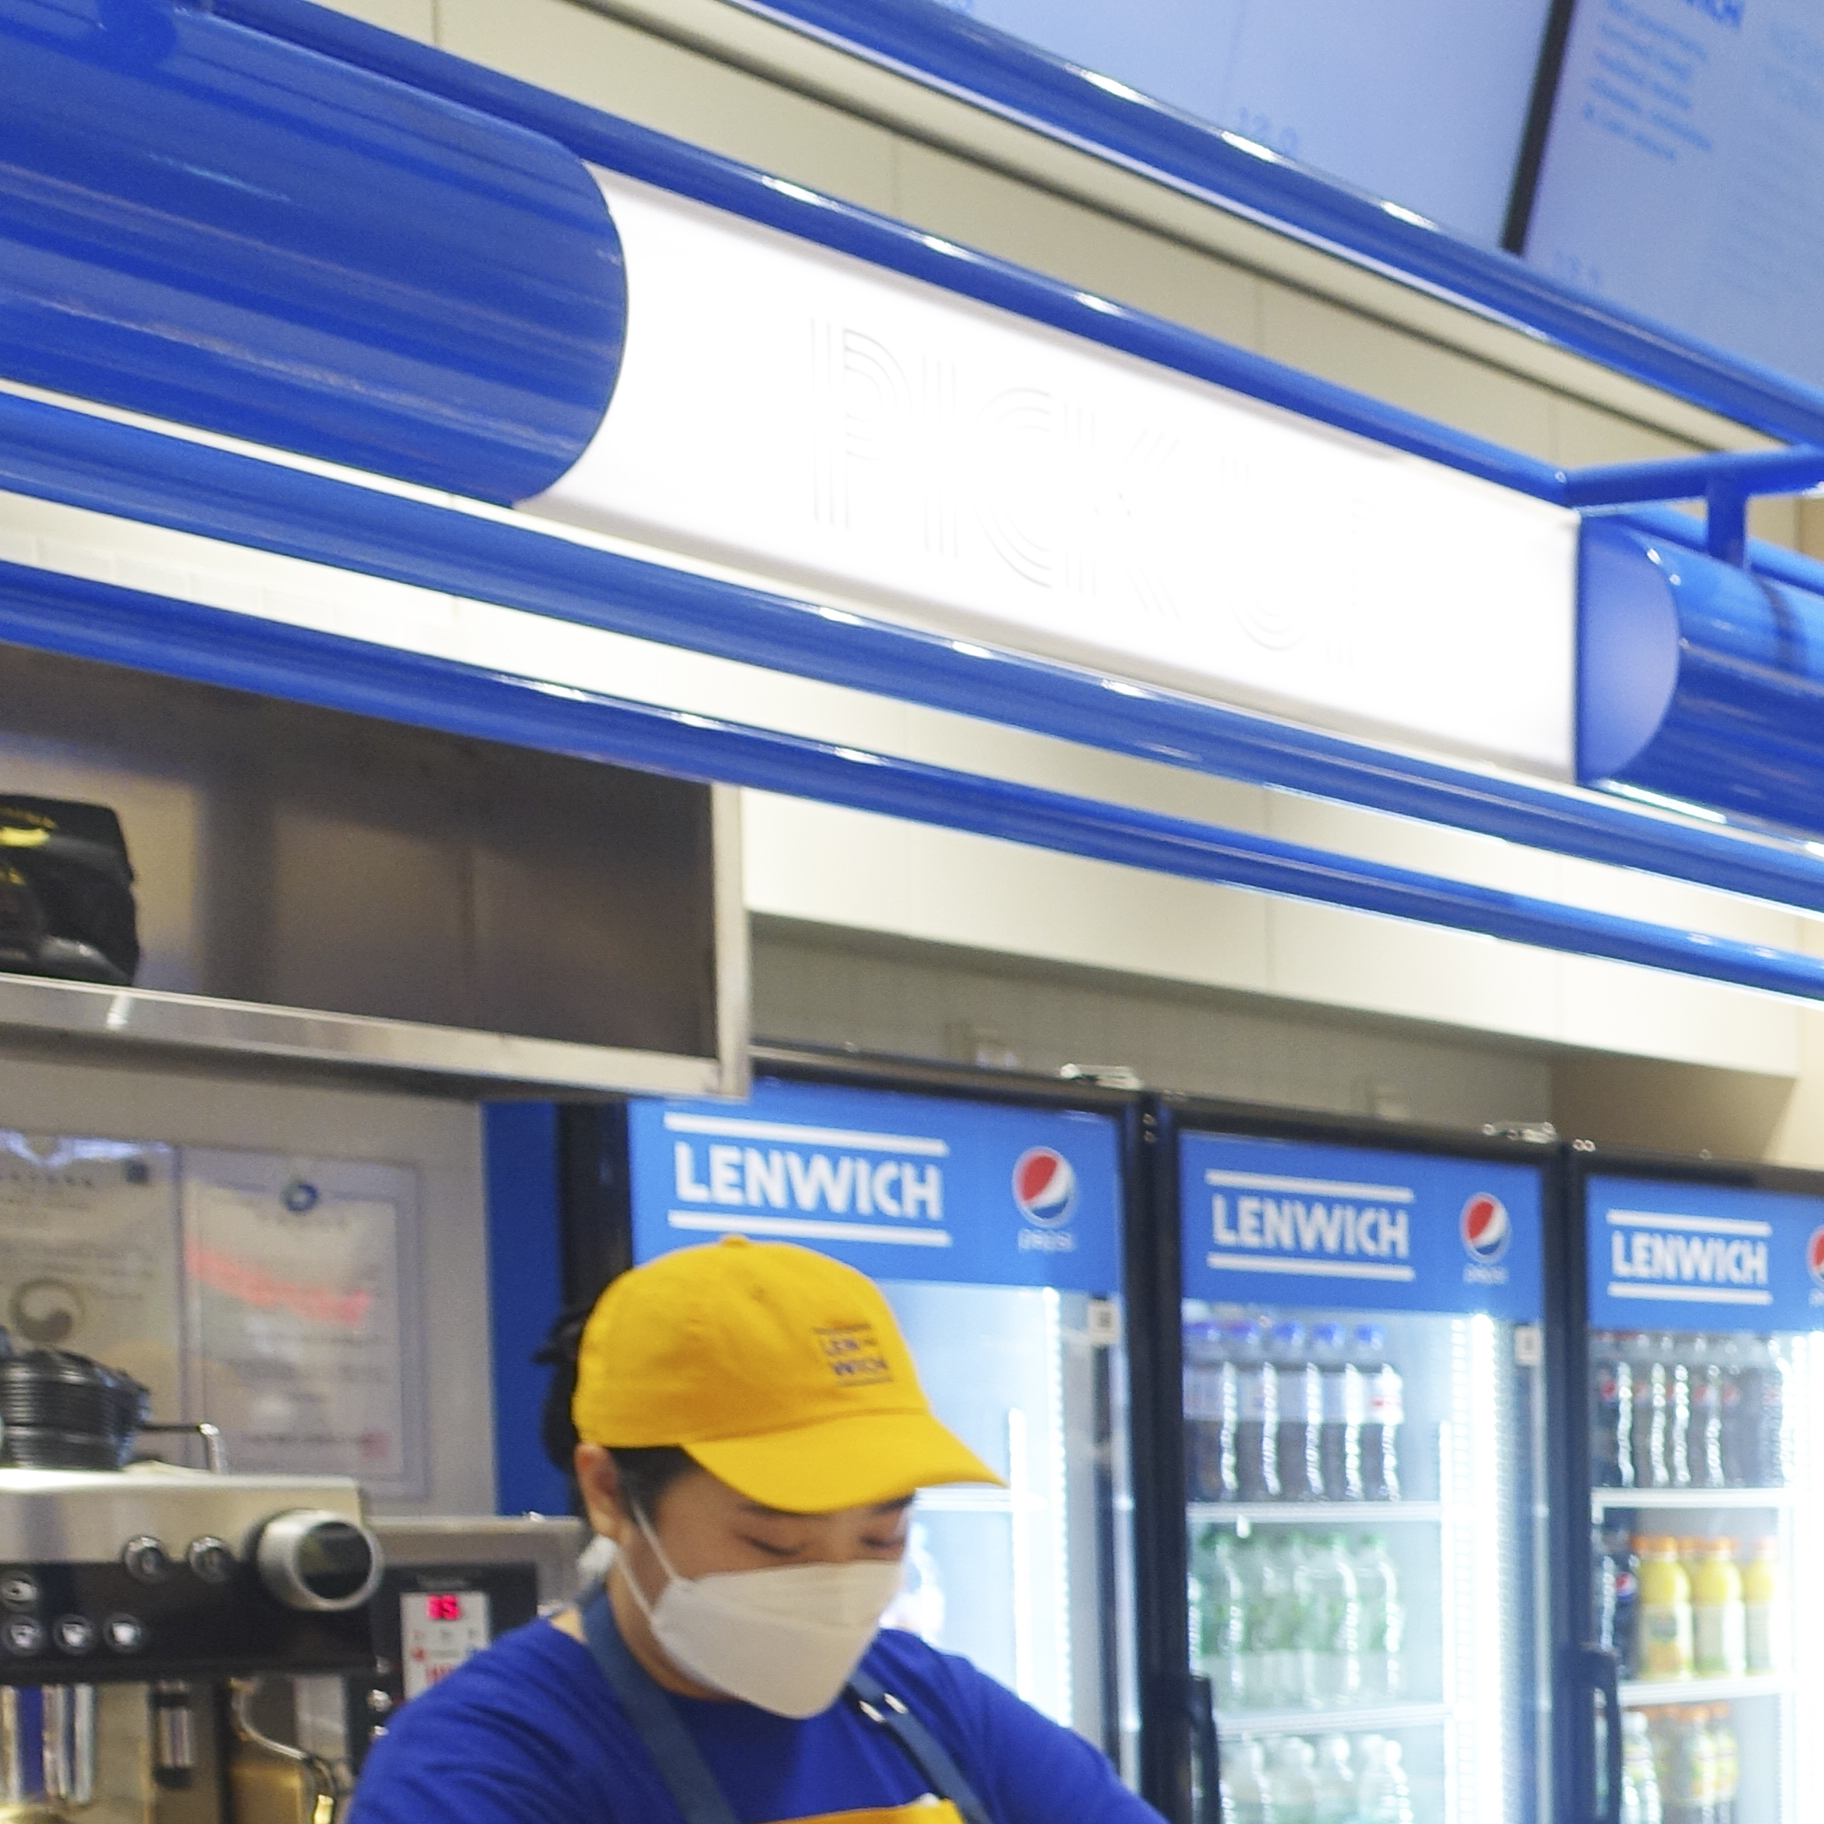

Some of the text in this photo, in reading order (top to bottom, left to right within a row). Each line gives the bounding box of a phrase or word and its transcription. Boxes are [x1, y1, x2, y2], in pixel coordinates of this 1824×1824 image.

[673, 1138, 946, 1223] LENWICH
[1210, 1192, 1410, 1261] LENWICH
[1609, 1229, 1769, 1287] LENWICH
